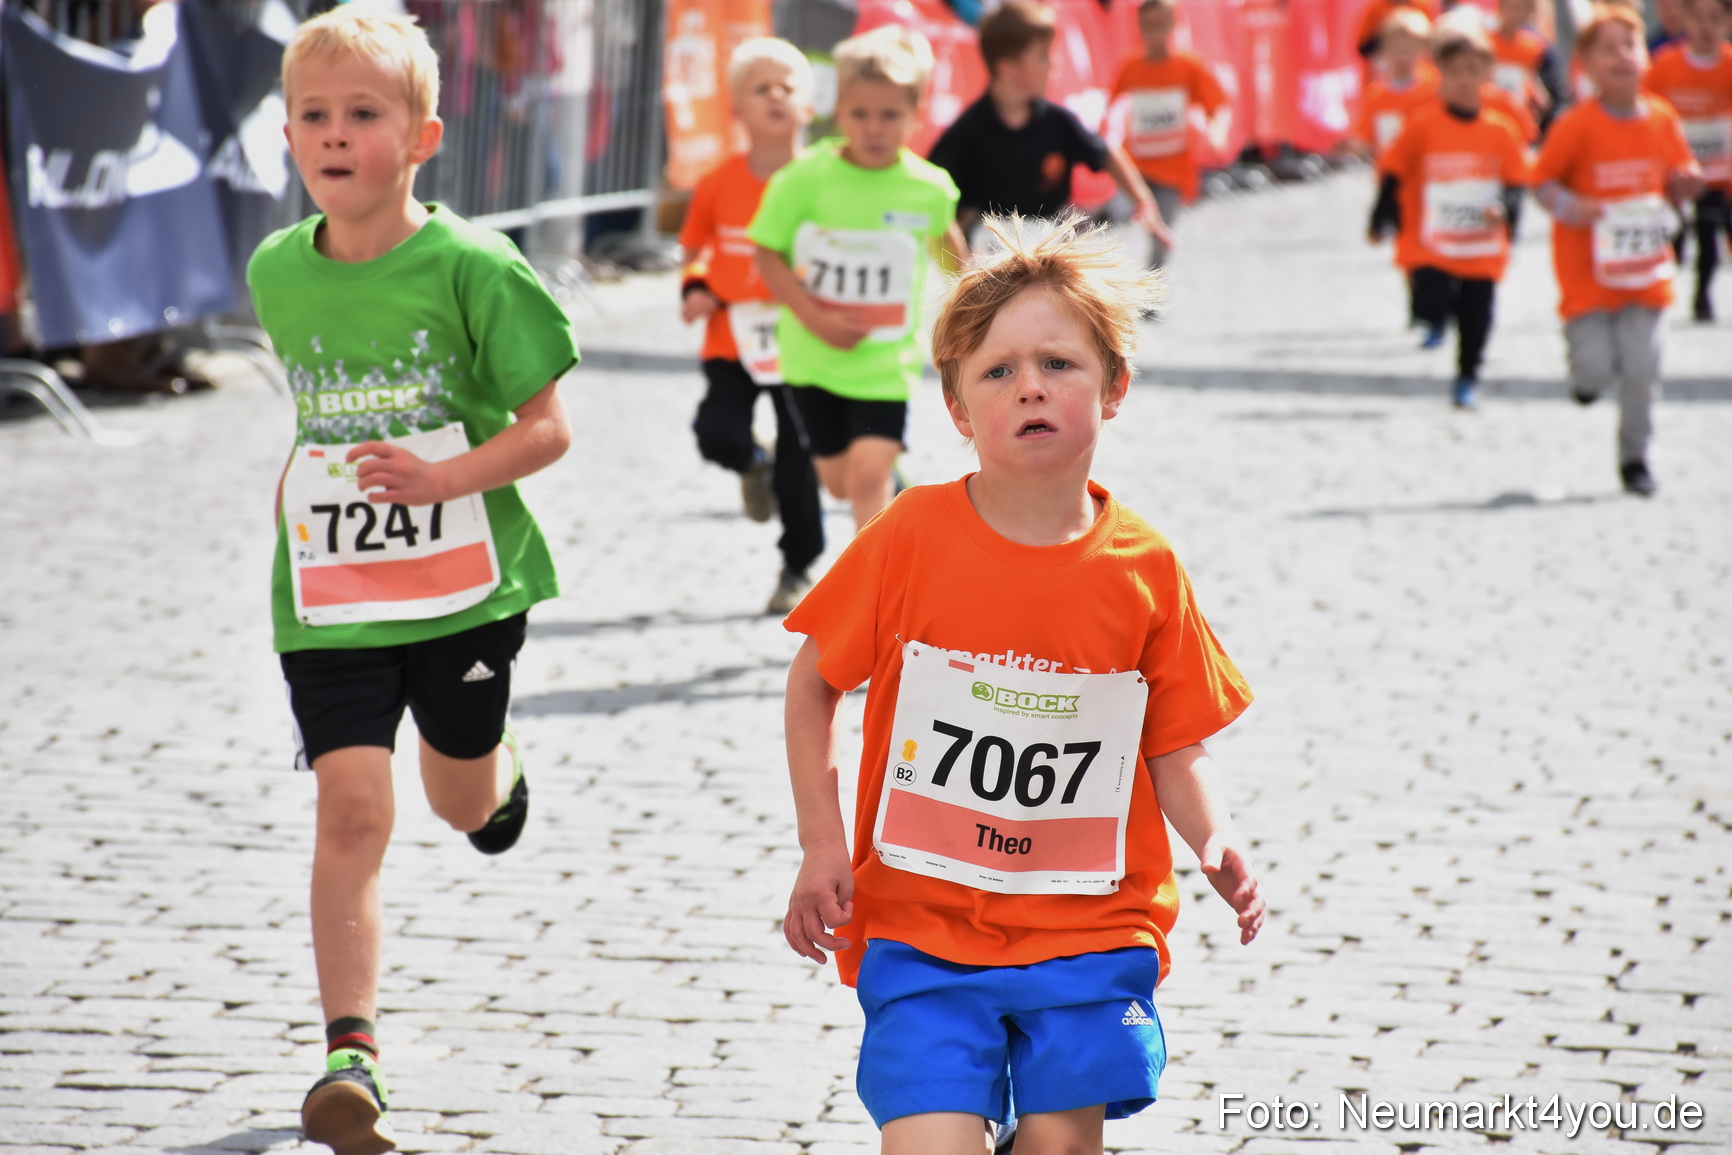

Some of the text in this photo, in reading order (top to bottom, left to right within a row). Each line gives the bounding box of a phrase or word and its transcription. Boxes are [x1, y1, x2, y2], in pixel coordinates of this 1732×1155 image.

[810, 258, 891, 297] 7111
[317, 383, 427, 417] BOCK
[310, 501, 444, 554] 7247
[993, 705, 1079, 721] inspired by smart concepts
[995, 687, 1080, 713] BOCK
[896, 766, 913, 782] B2
[931, 719, 1102, 808] 7067
[975, 823, 1032, 855] Theo
[1121, 1015, 1154, 1026] adidas
